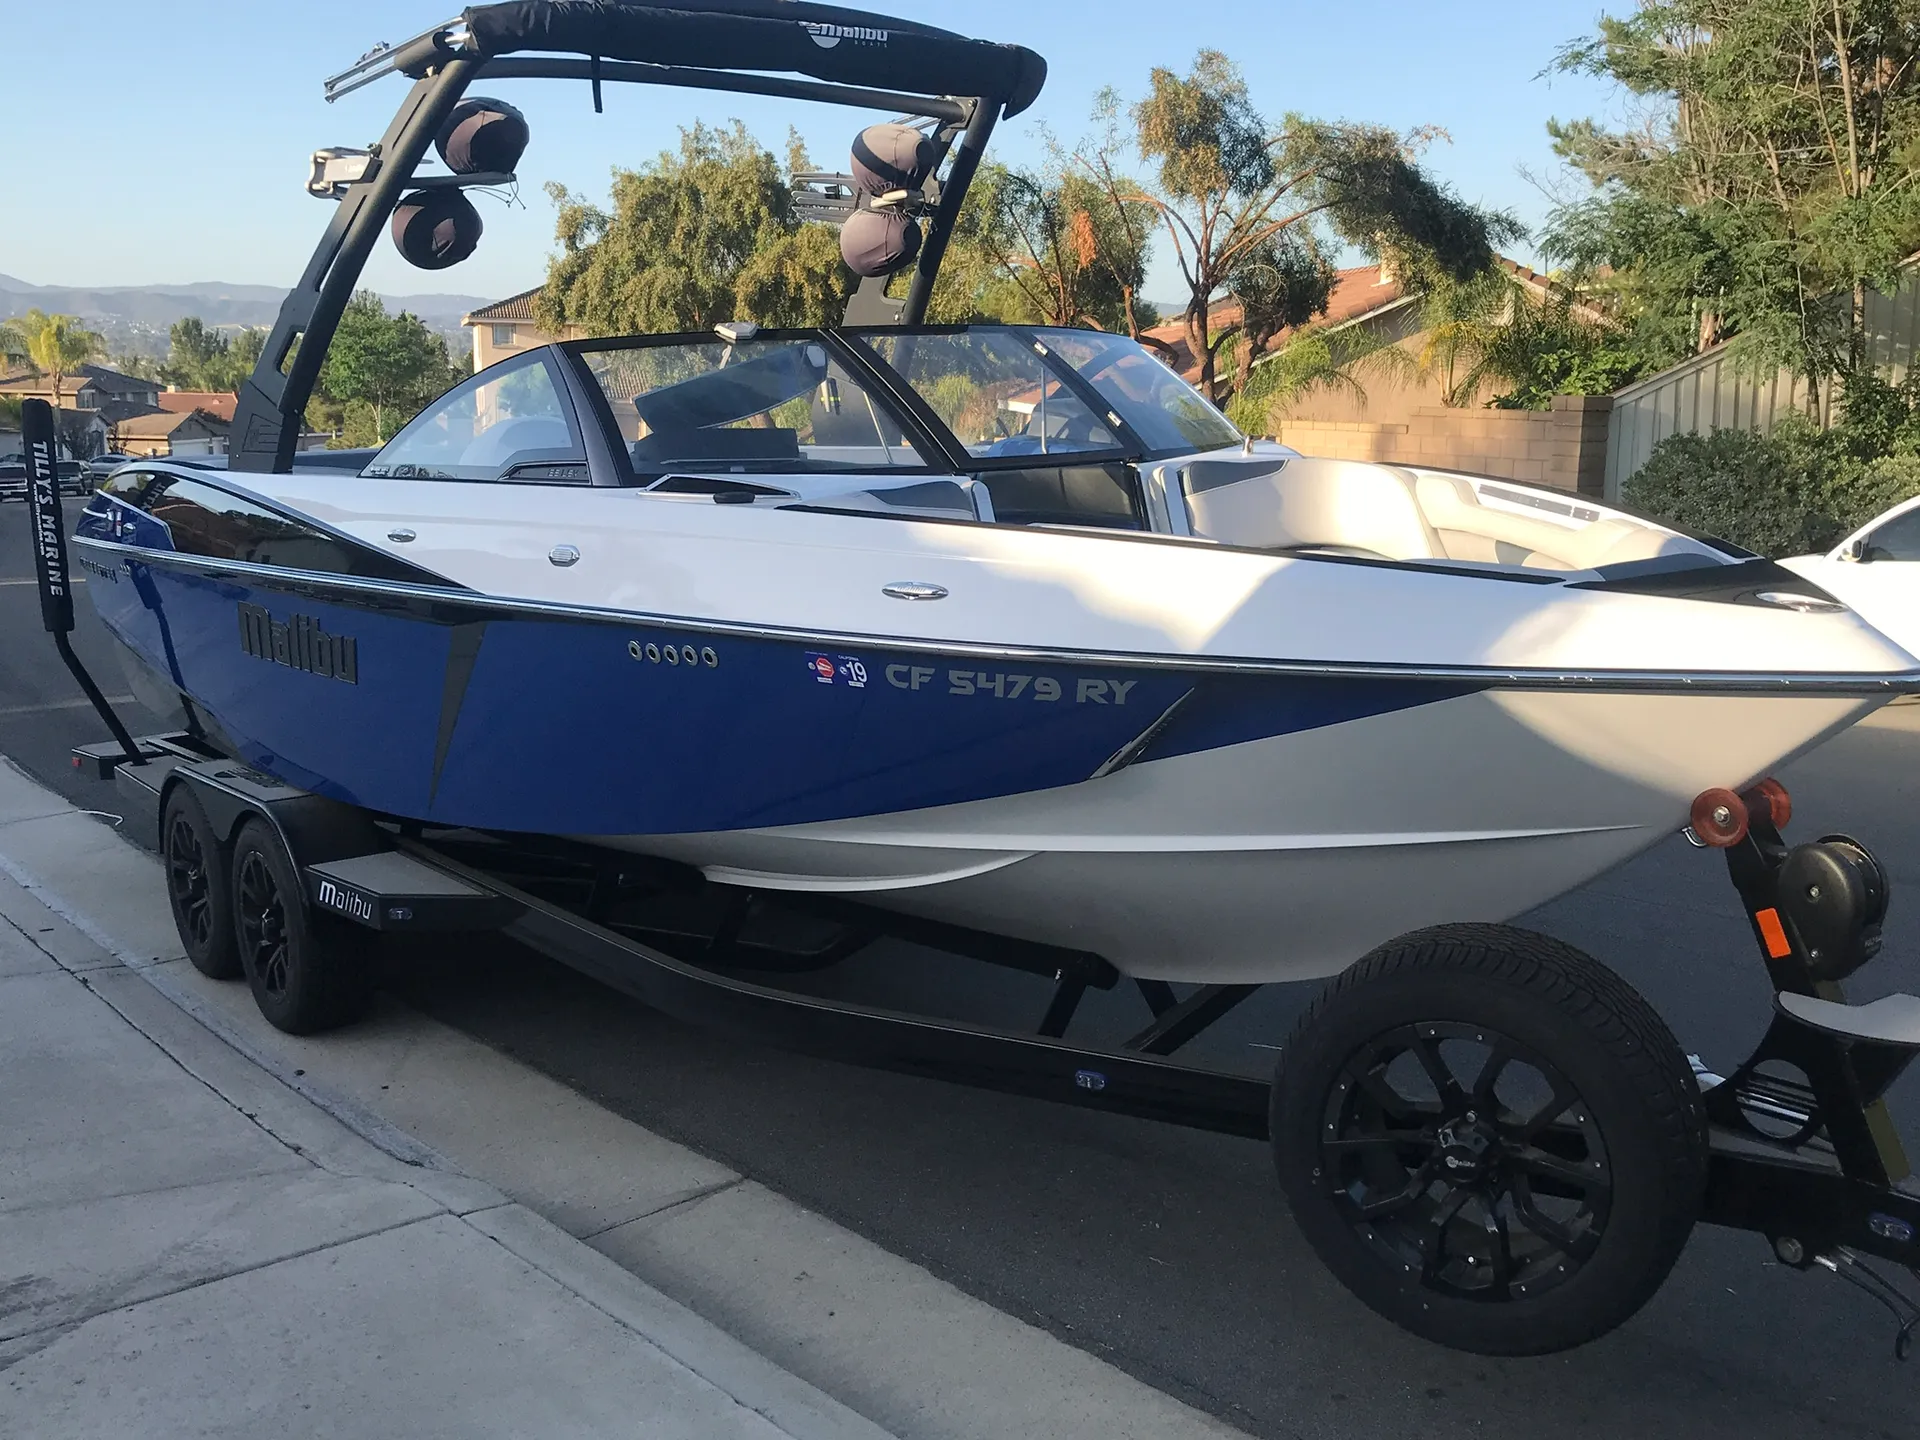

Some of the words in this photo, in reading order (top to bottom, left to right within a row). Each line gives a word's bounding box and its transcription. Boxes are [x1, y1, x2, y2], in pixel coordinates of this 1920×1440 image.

[854, 40, 887, 48] BOATS
[33, 440, 54, 506] TILLY'S
[41, 513, 64, 597] MARINE
[238, 600, 358, 685] Malibu
[846, 661, 868, 683] 19
[885, 663, 936, 690] CF
[948, 669, 1063, 702] 5479
[1076, 678, 1138, 705] RY
[319, 880, 372, 920] Malibu
